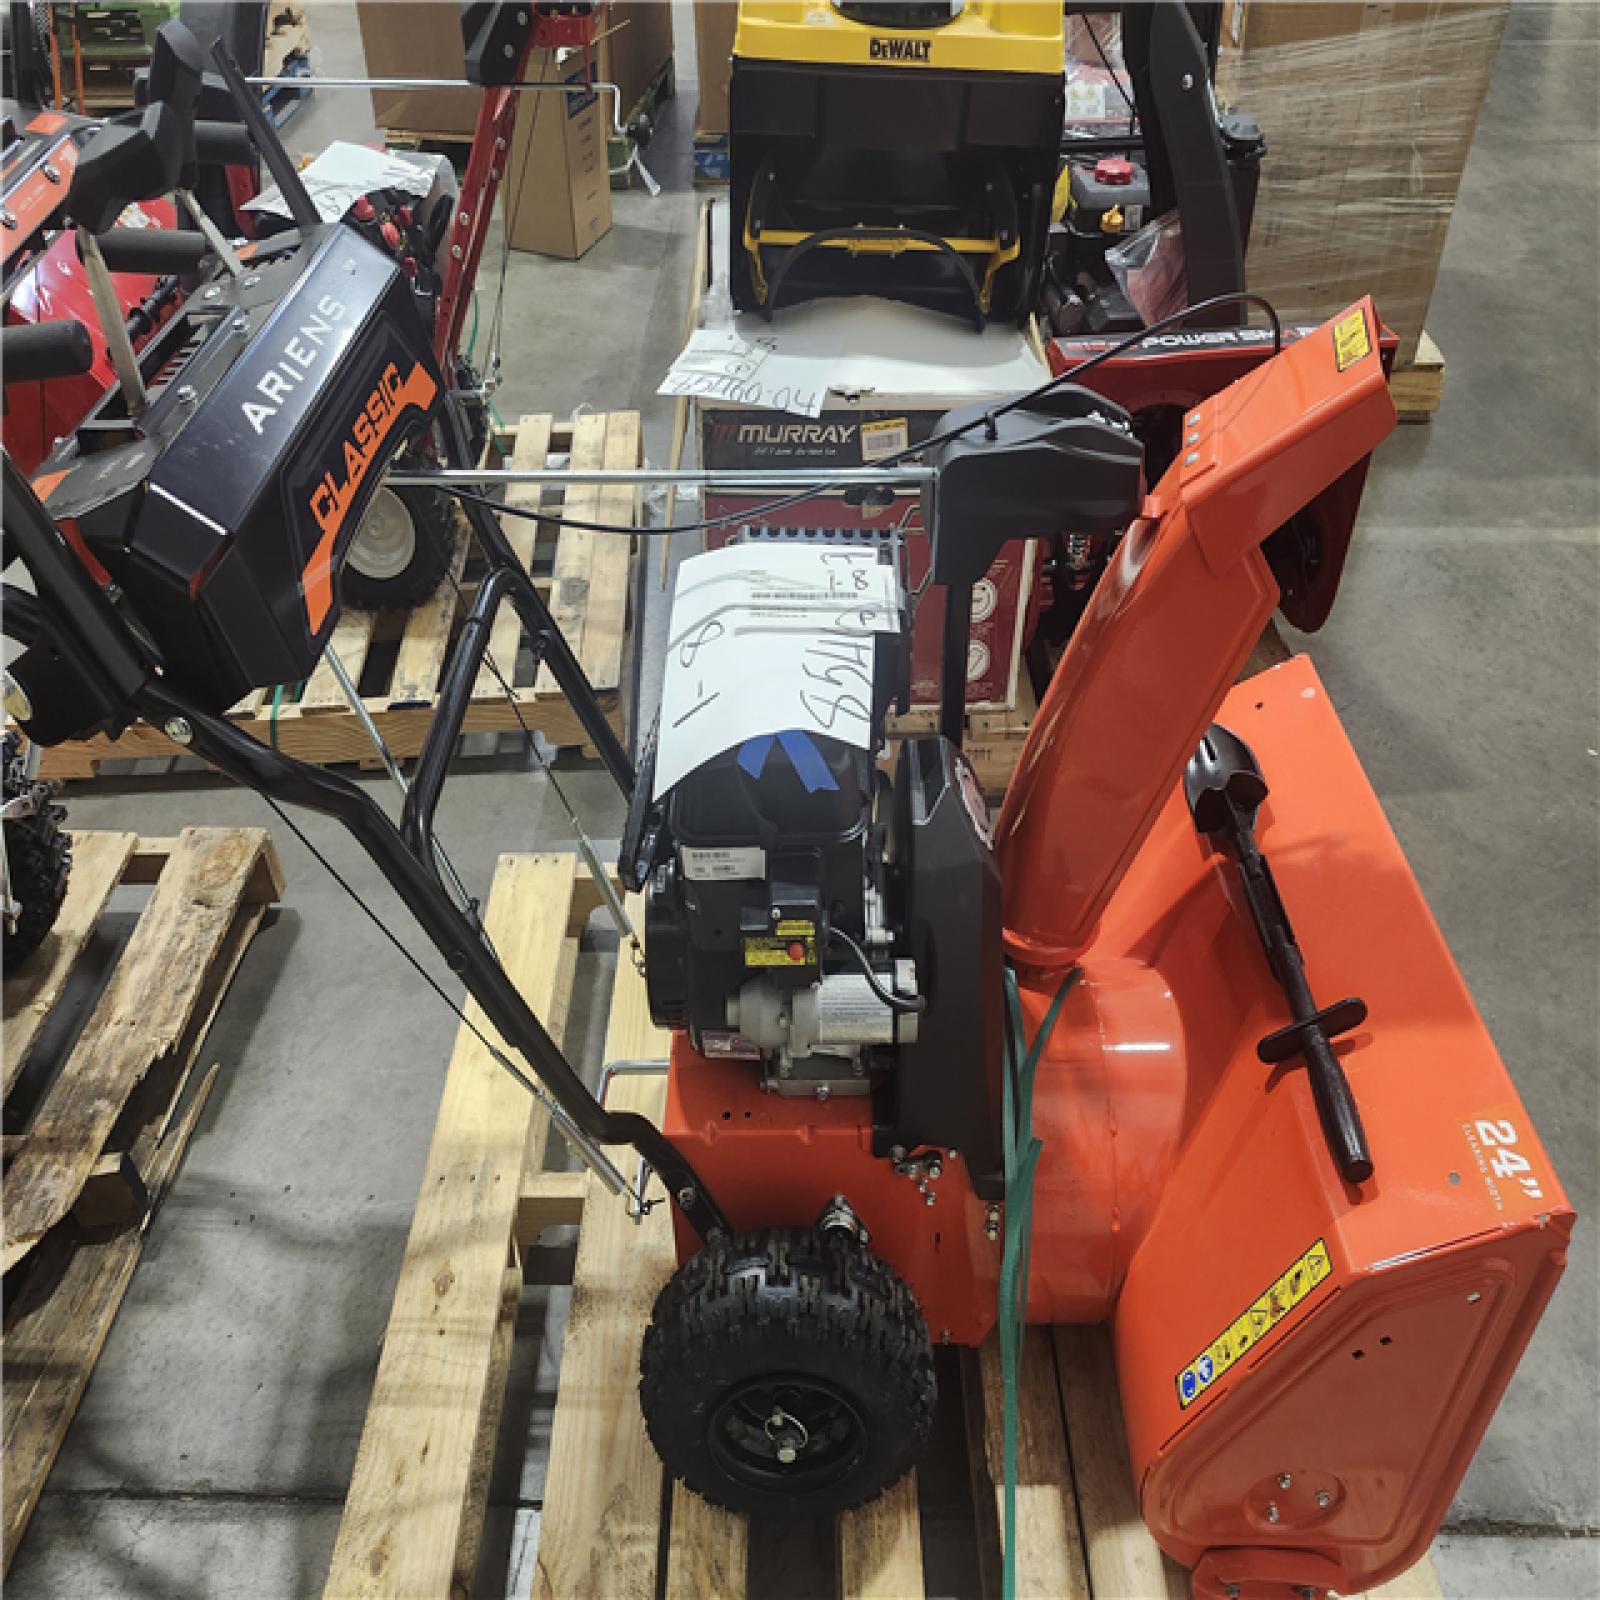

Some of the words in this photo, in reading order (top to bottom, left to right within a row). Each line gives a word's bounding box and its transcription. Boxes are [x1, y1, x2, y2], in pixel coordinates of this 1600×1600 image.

[242, 294, 346, 434] ARIENS
[310, 362, 402, 531] CLASSIC
[737, 425, 857, 444] MURRAY
